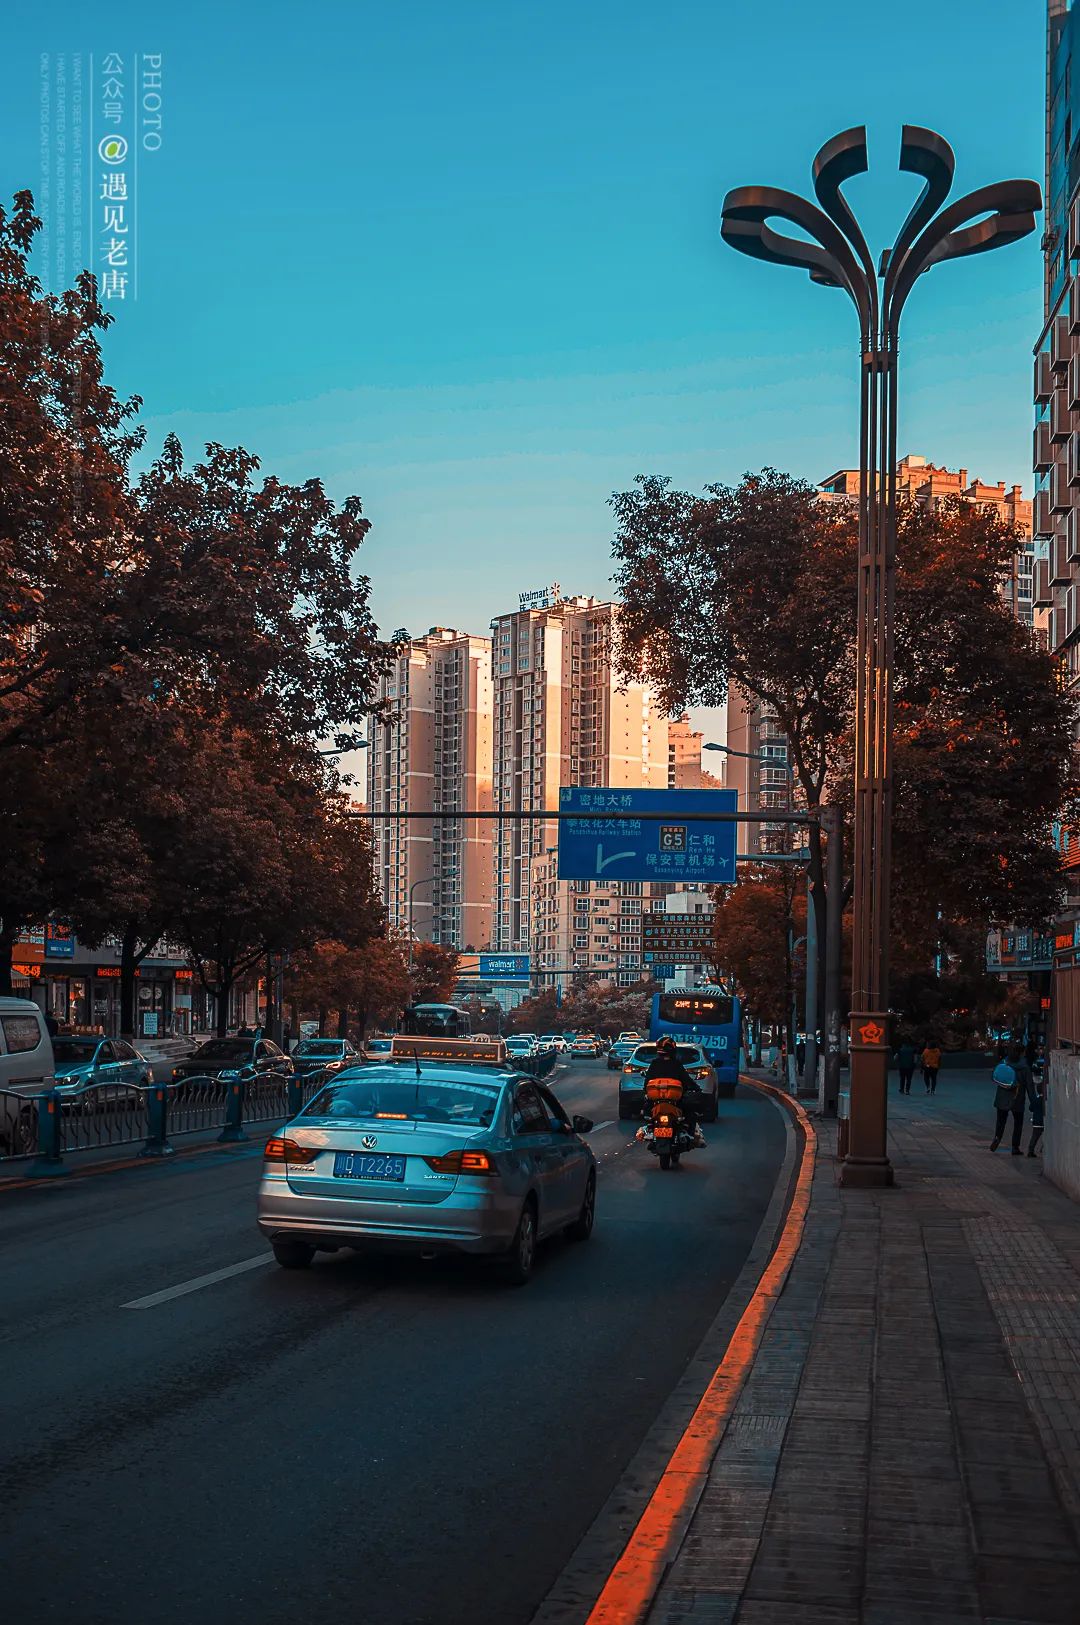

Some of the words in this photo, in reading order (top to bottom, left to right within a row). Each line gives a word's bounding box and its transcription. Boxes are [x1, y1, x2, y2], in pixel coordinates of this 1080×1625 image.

[519, 587, 549, 603] Walmart
[579, 794, 633, 807] 密地大桥
[663, 833, 683, 846] G5
[688, 834, 715, 846] 仁和
[646, 853, 715, 866] 保安营机场
[685, 867, 705, 875] Airport
[359, 1157, 404, 1174] T2265
